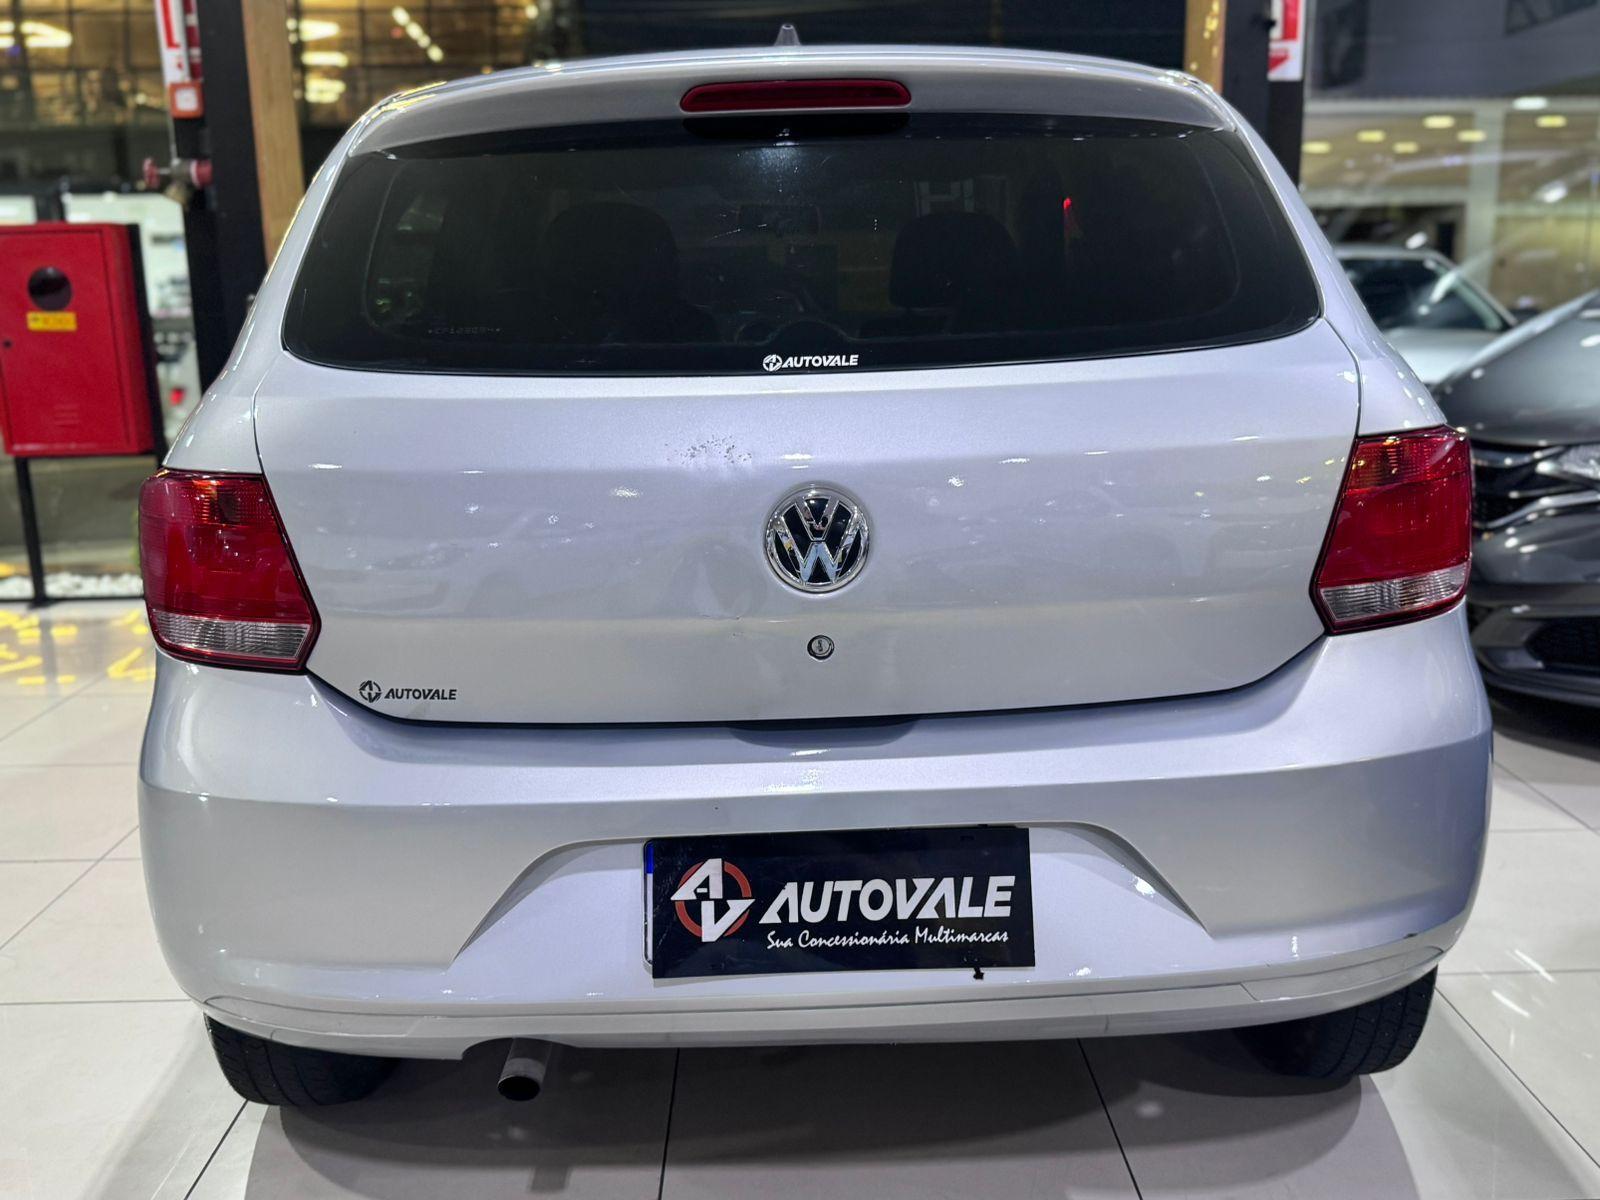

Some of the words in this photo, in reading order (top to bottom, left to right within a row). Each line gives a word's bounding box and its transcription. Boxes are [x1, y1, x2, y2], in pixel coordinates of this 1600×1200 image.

[782, 354, 859, 368] AUTOVALE
[384, 688, 457, 700] AUTOVALE
[759, 875, 1015, 924] AUTOVALE
[766, 931, 793, 949] Sua
[798, 930, 910, 948] Concessionária
[915, 926, 1009, 944] Multimarcas
